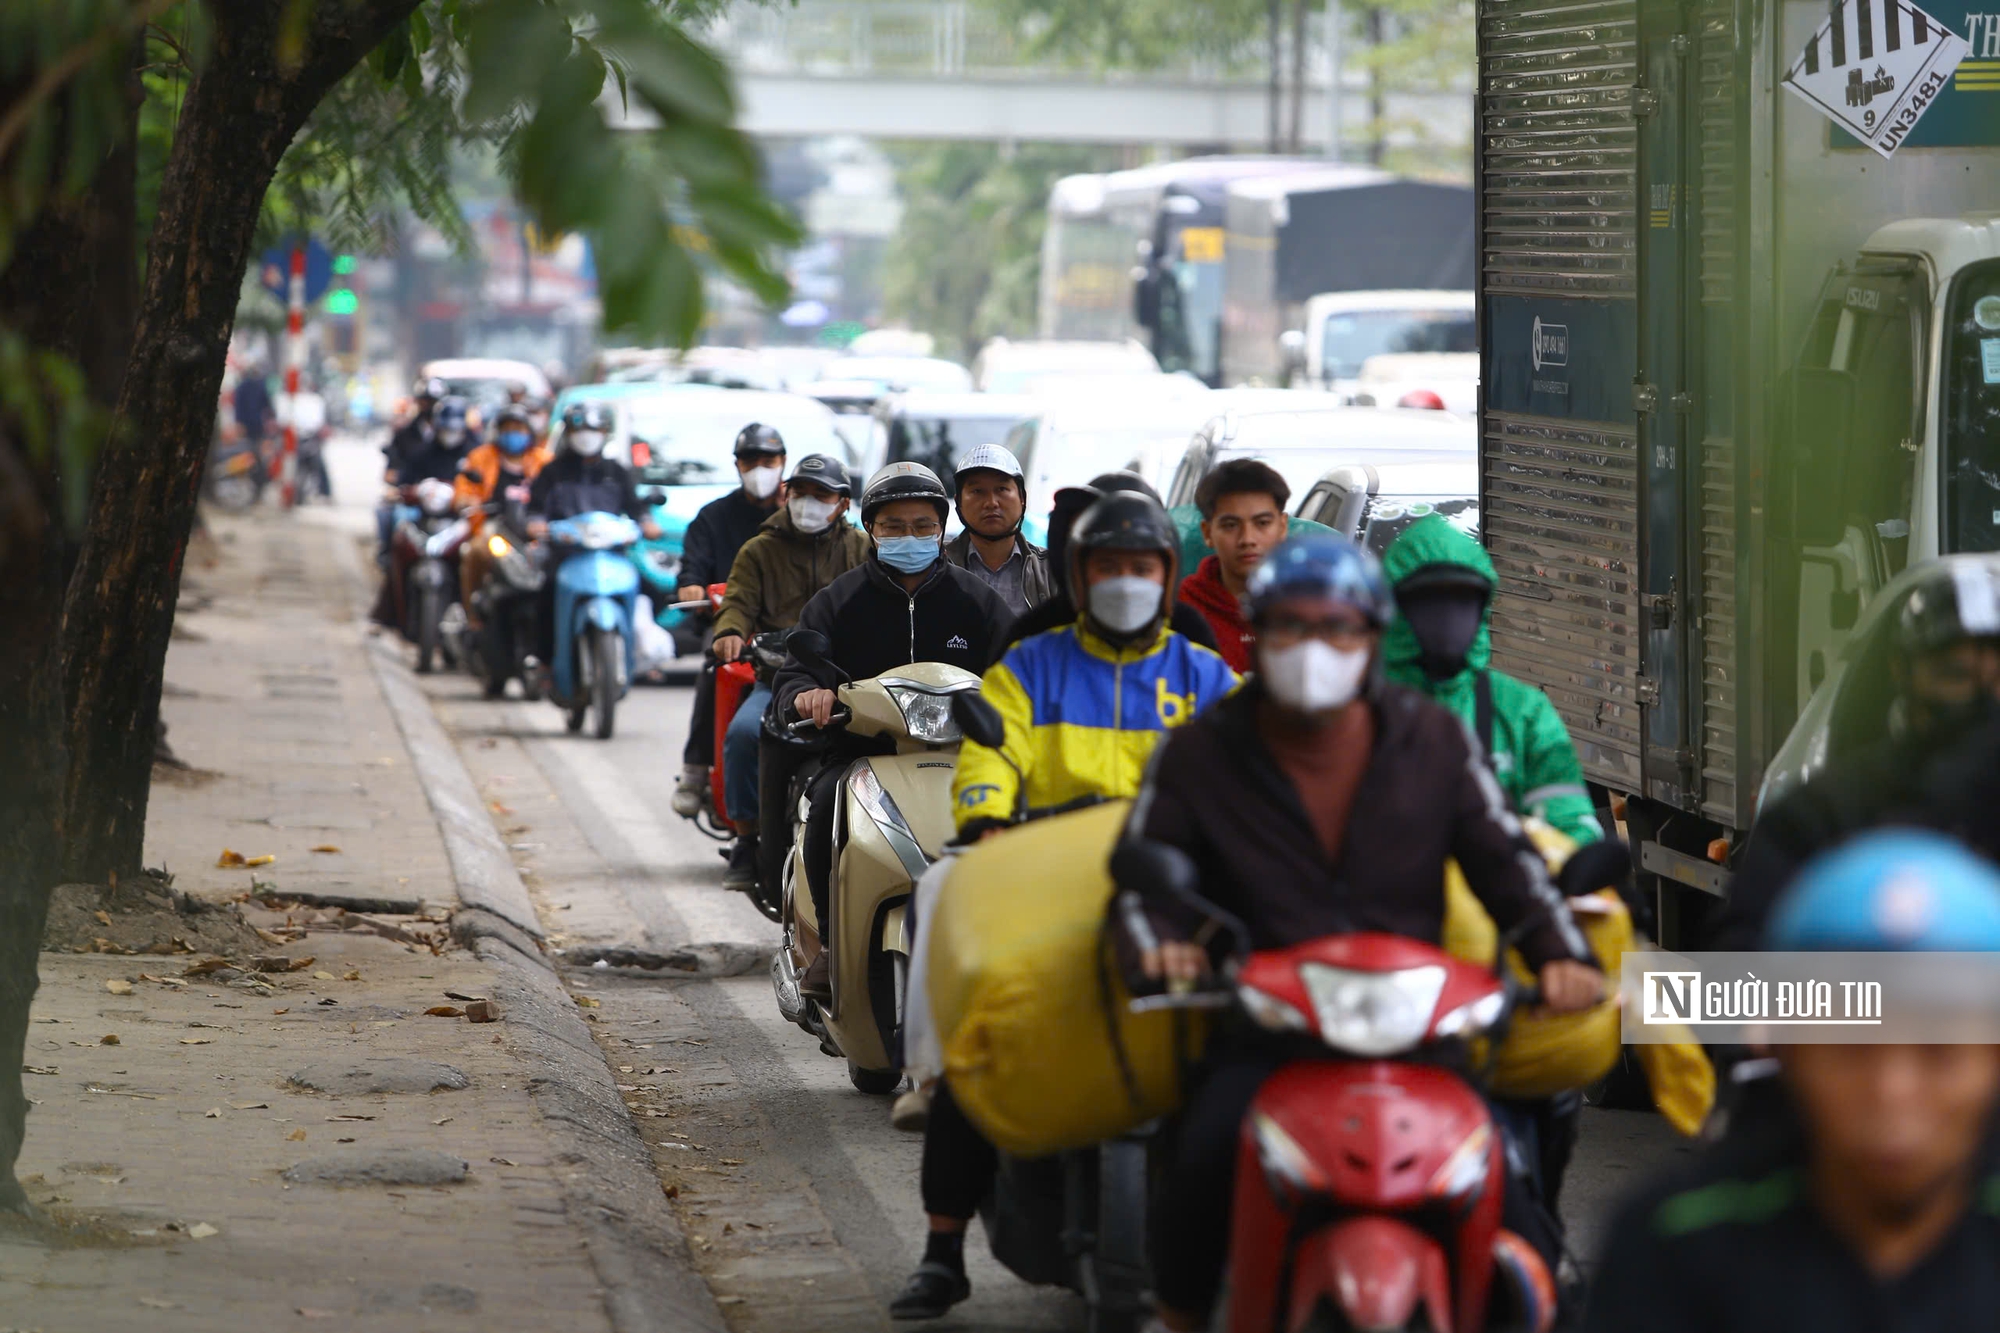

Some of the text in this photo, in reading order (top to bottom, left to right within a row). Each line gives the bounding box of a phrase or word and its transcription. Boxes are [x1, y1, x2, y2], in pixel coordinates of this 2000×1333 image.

[1863, 110, 1876, 127] 9
[1879, 70, 1948, 152] UN3481
[1846, 286, 1880, 310] ISUZU
